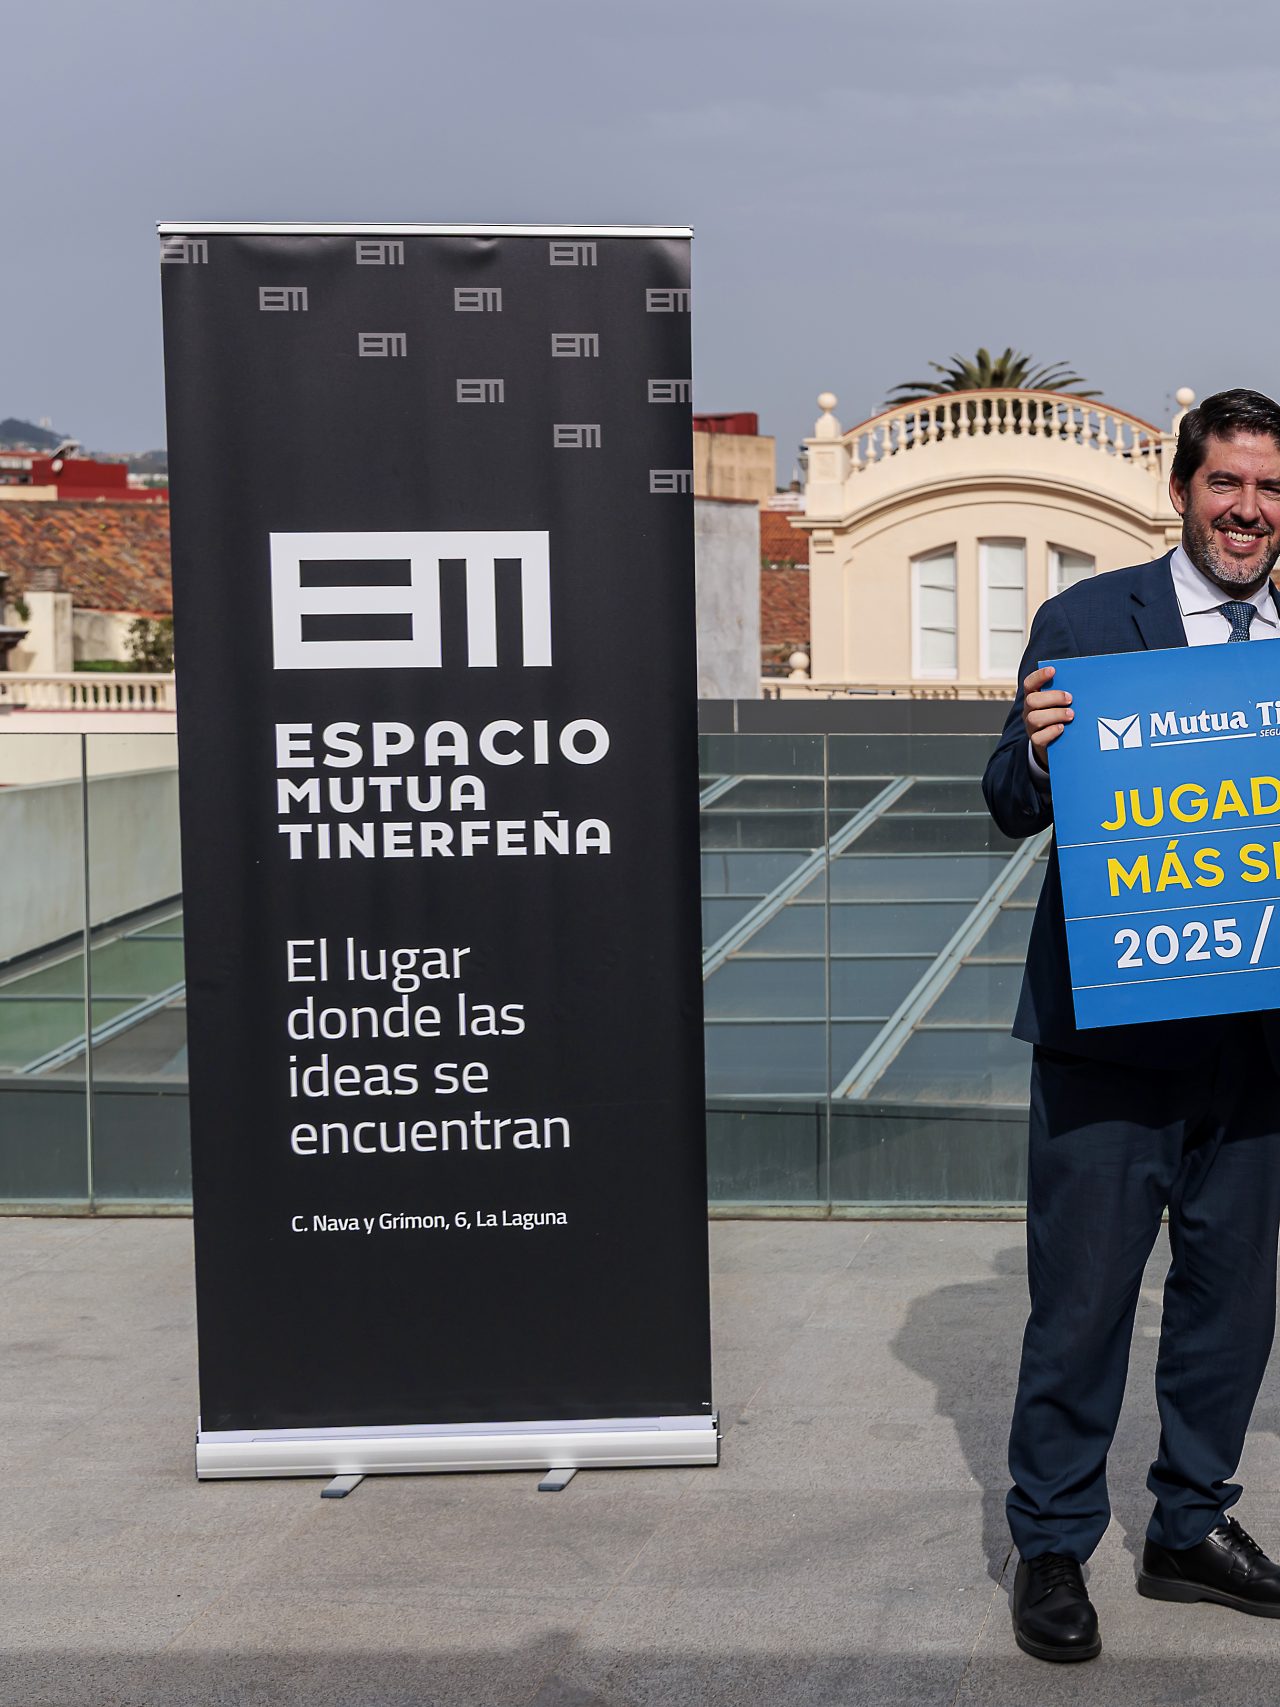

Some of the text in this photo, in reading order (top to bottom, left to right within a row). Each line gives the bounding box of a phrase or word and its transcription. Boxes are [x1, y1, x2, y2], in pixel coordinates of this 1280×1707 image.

[275, 719, 610, 768] ESPACIO
[1149, 708, 1248, 738] Mutua
[277, 774, 486, 814] MUTUA
[278, 810, 611, 860] TINERFEÑA
[1106, 839, 1225, 897] MÁS
[286, 937, 471, 993] El lugar
[287, 992, 526, 1040] donde las
[289, 1053, 489, 1098] ideas se
[290, 1110, 571, 1155] encuentran
[291, 1210, 568, 1234] C. Nava y Grimon, 6, La Laguna
